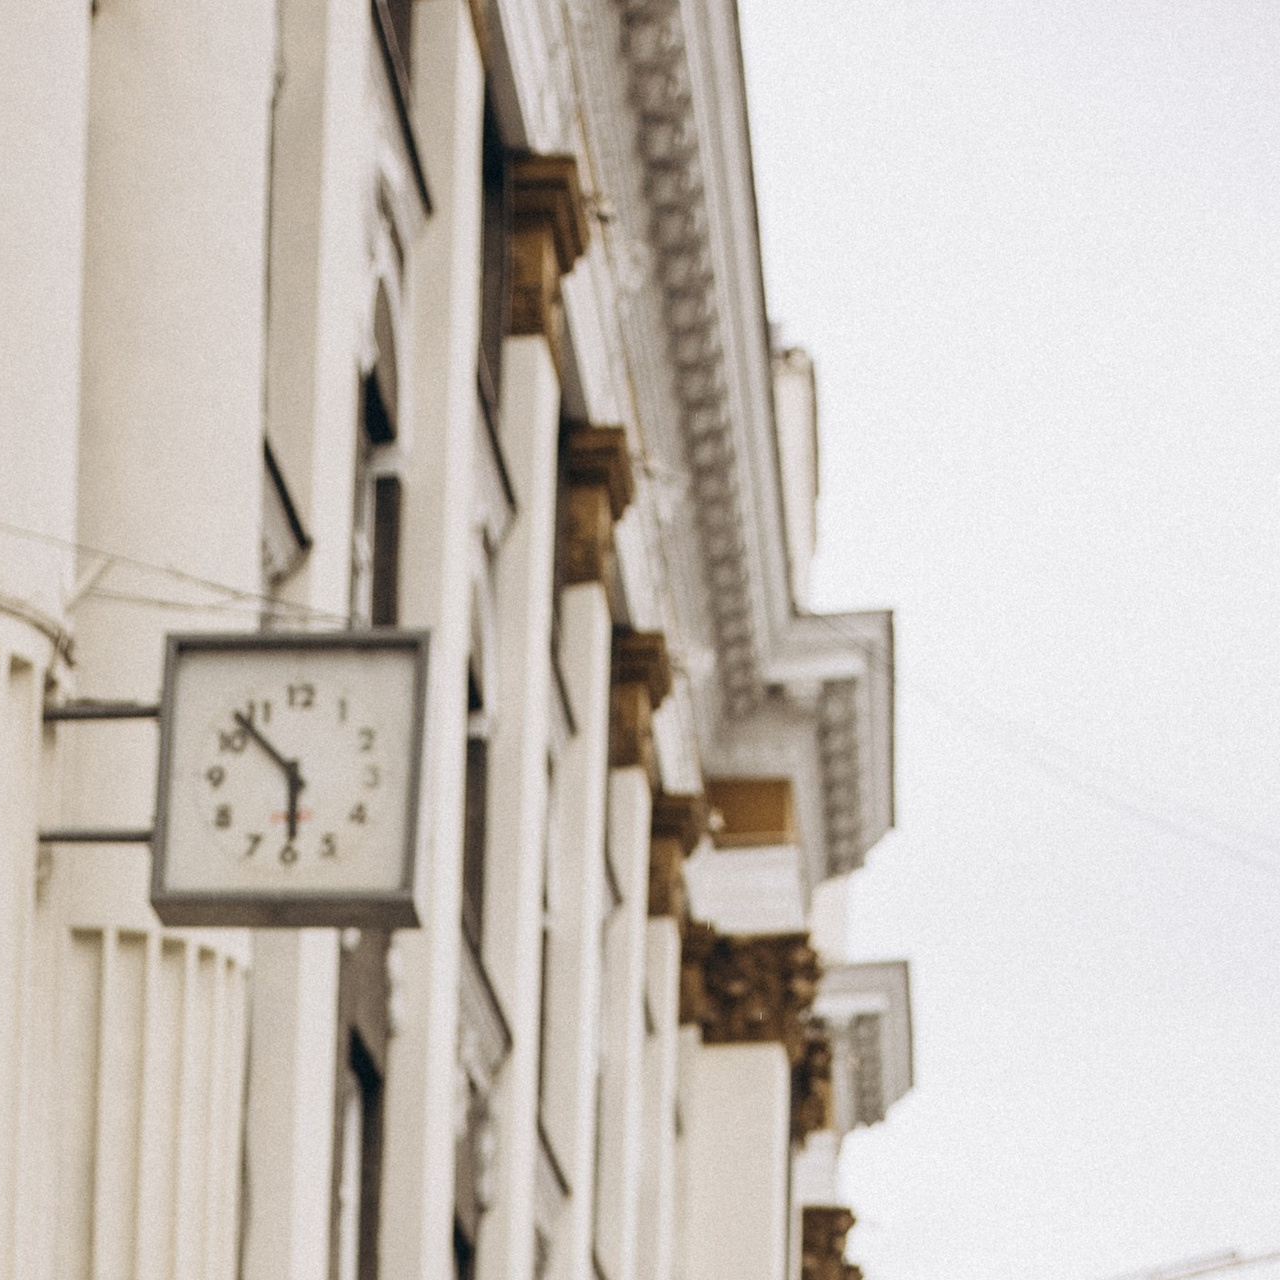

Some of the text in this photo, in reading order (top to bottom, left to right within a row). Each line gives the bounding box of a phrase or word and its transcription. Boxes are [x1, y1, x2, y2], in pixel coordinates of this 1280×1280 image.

[286, 683, 315, 709] 12
[247, 699, 271, 725] 11
[358, 727, 376, 751] 2
[206, 765, 225, 789] 9
[215, 802, 232, 830] 8
[348, 802, 368, 826] 4
[245, 832, 262, 858] 7
[279, 843, 298, 866] 6
[321, 832, 337, 858] 5
